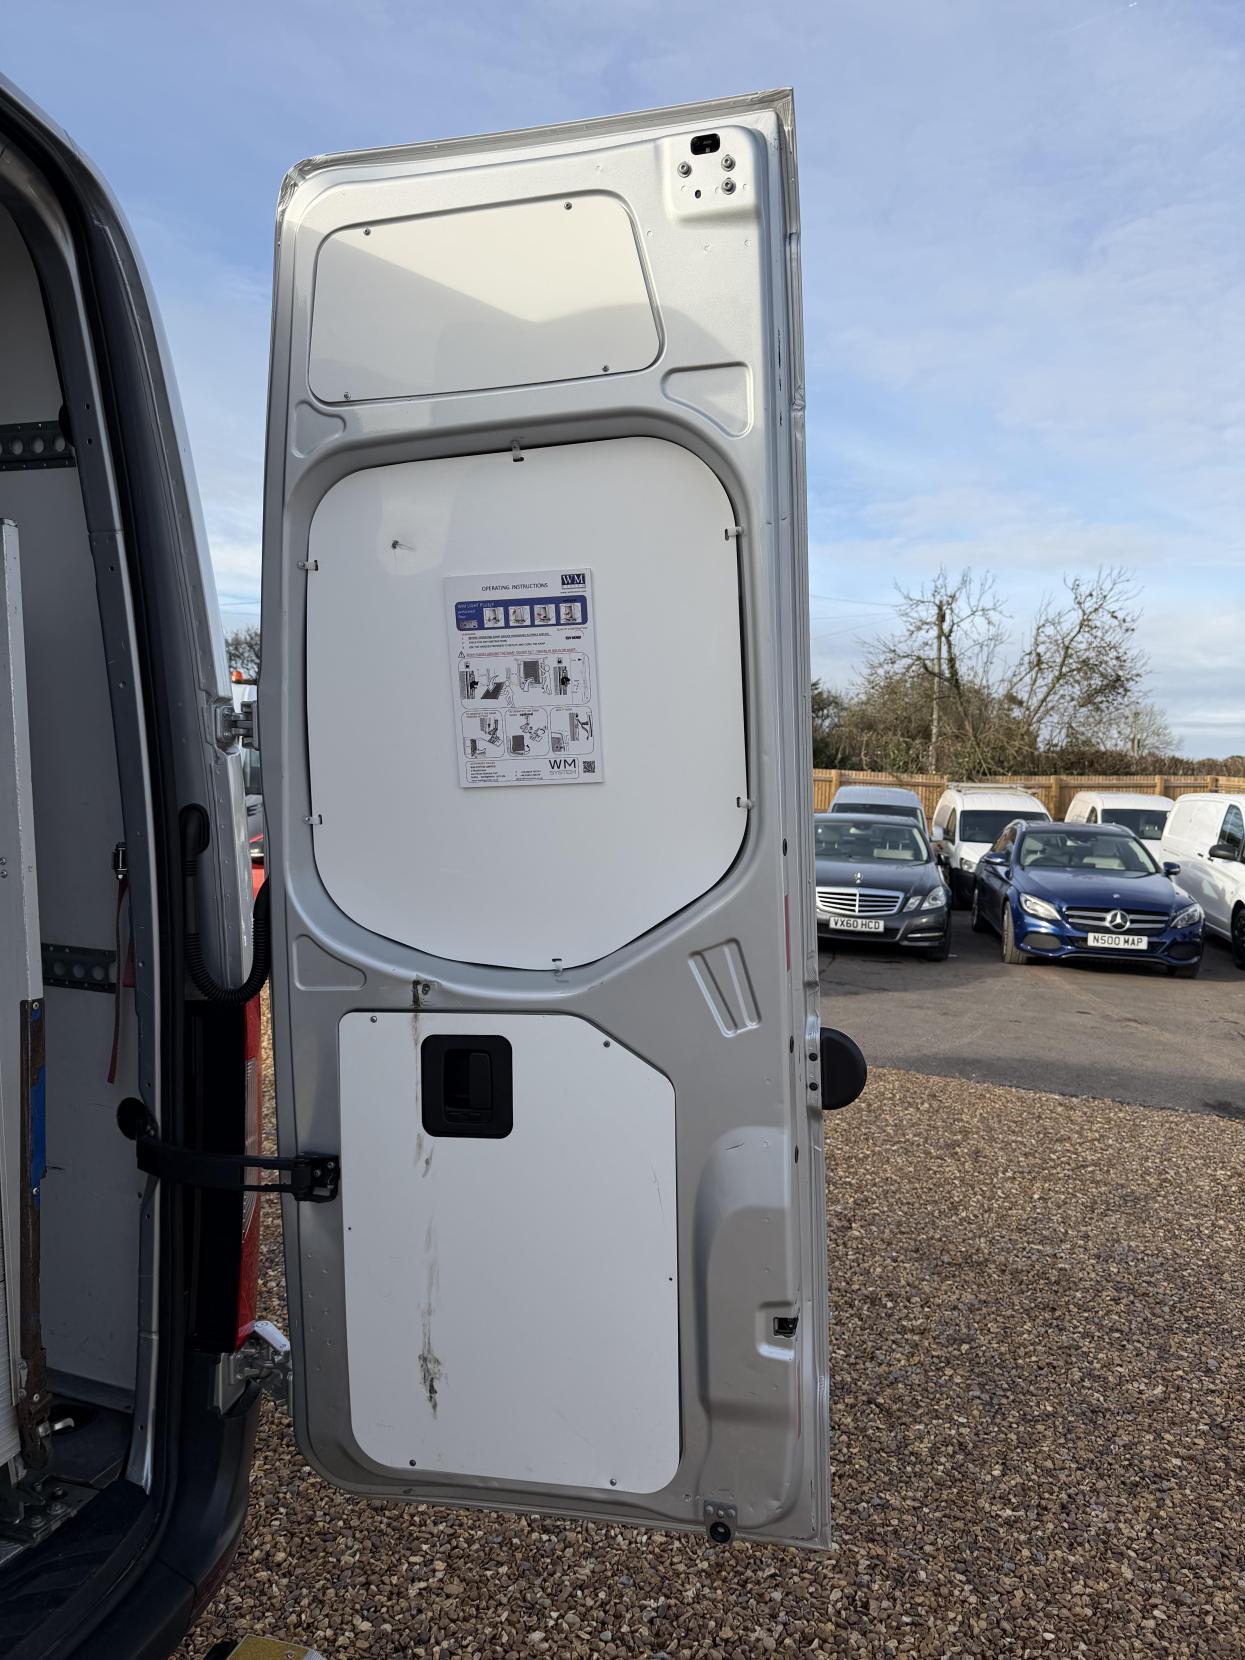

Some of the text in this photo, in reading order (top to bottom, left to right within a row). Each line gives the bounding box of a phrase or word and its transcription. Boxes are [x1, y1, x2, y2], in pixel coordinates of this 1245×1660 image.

[562, 574, 584, 584] WM
[481, 582, 548, 592] OPERATING INSTRUCTIONS
[548, 758, 577, 770] WM
[832, 918, 881, 930] VX60 HCD
[1123, 936, 1143, 947] MAP
